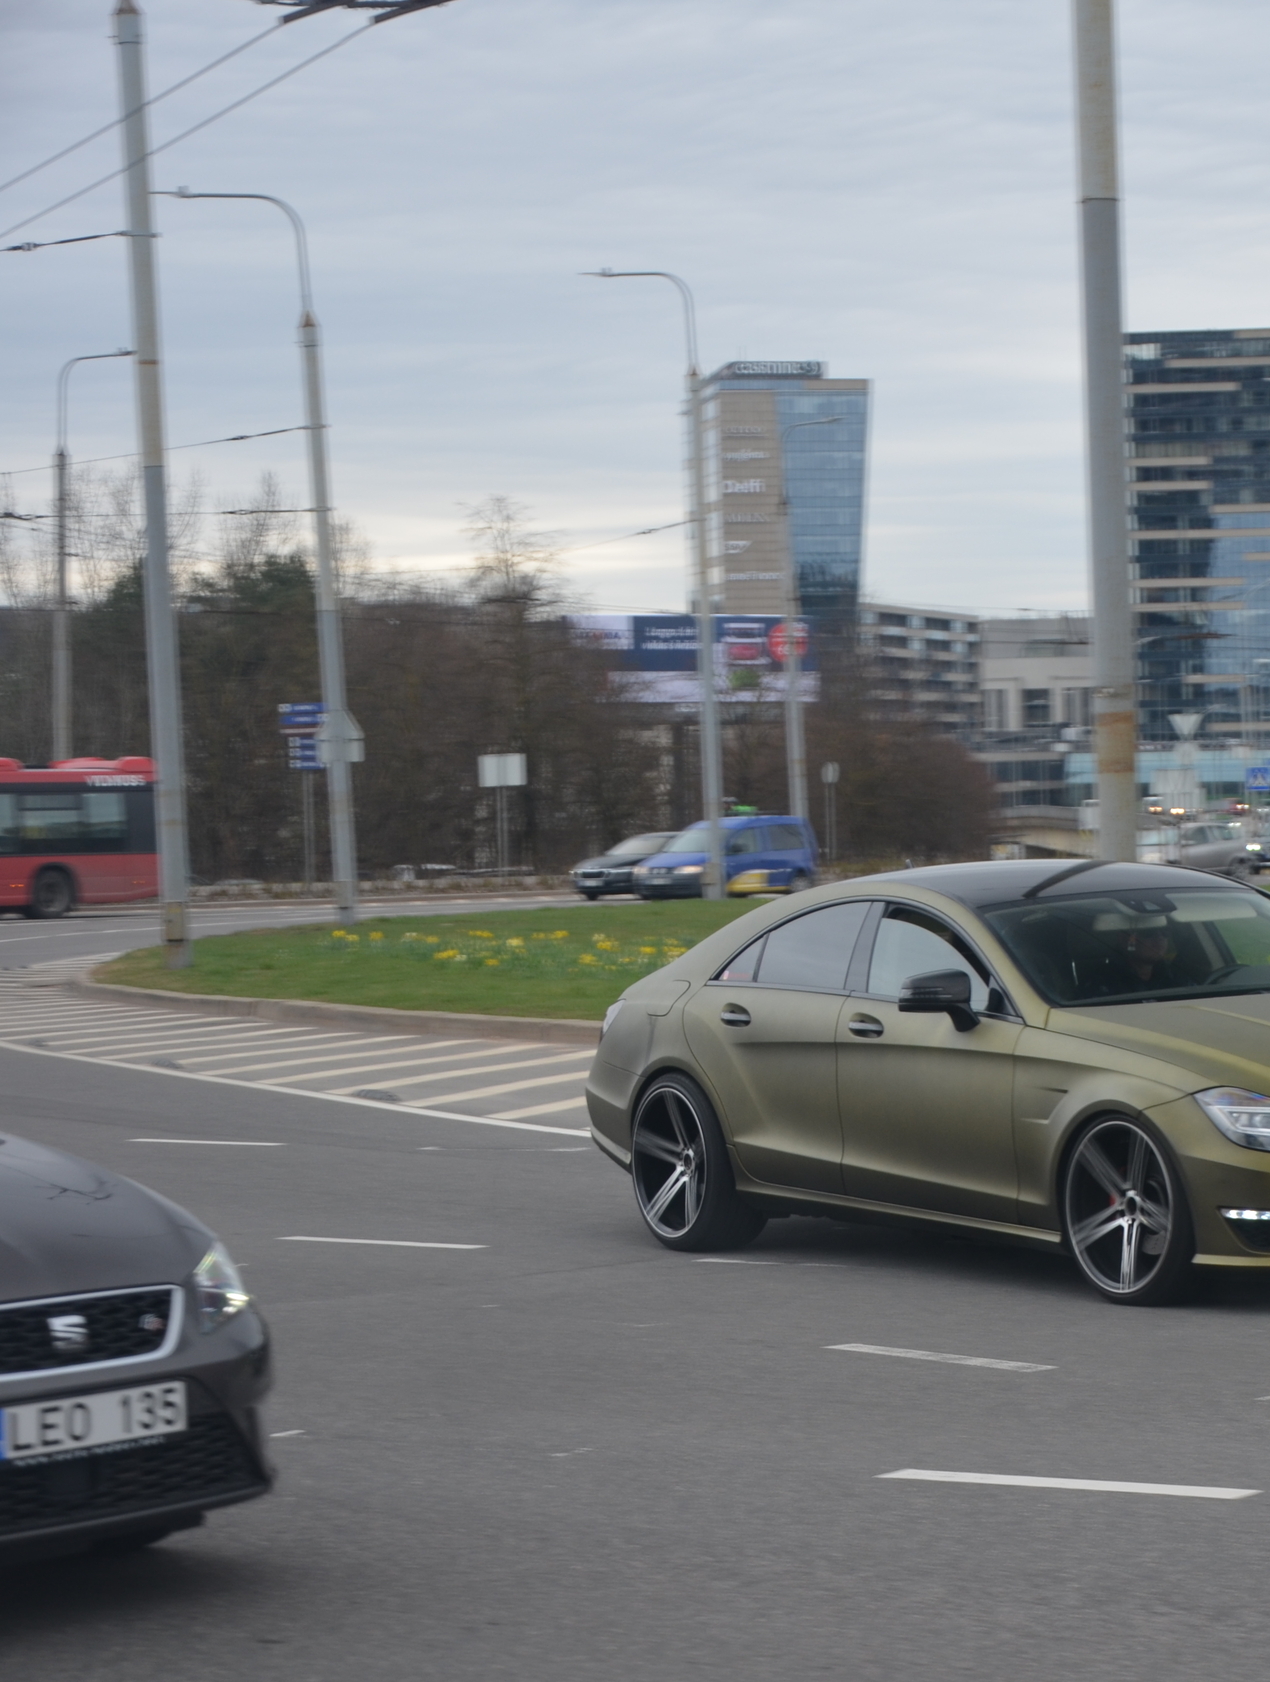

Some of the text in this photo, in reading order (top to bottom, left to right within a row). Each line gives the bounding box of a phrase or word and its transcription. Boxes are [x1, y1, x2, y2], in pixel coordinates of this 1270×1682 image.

[723, 480, 766, 493] Delfi
[7, 1402, 91, 1451] LEO
[119, 1387, 181, 1433] 135
